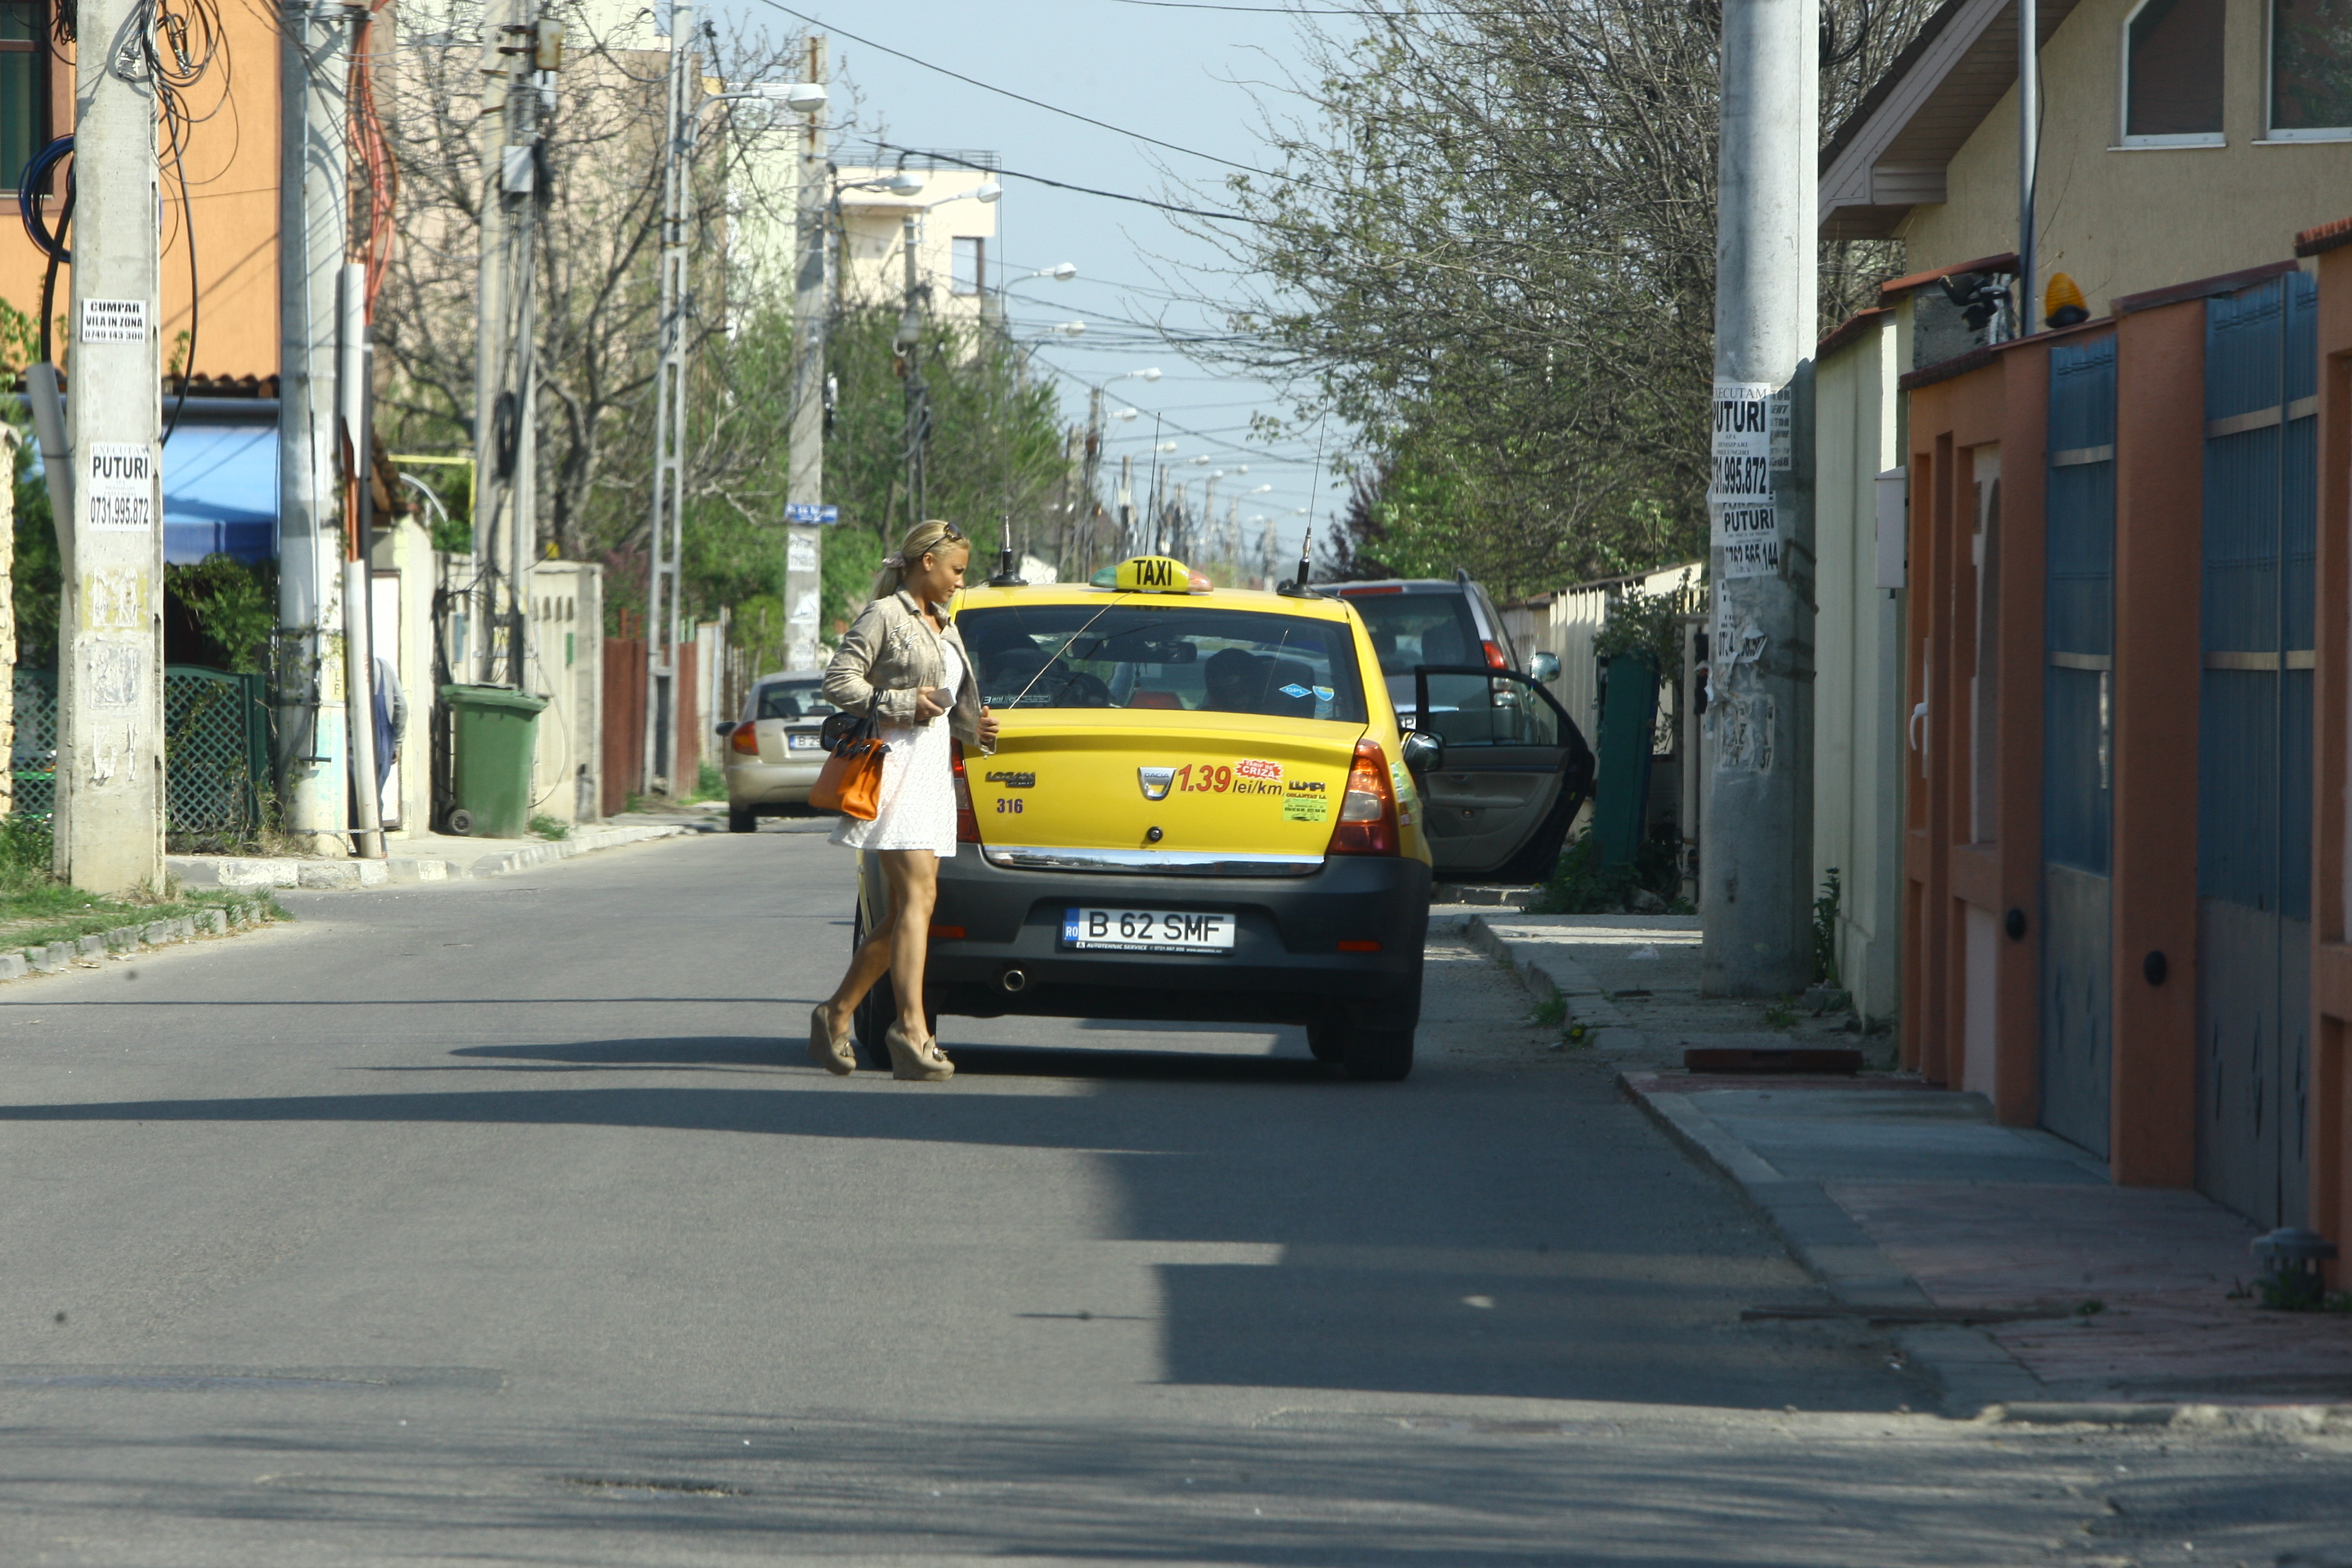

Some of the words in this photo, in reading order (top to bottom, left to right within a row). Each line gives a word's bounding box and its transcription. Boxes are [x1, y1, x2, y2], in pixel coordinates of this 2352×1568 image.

[90, 301, 140, 313] CUMPAR
[86, 315, 106, 326] VILA
[108, 315, 117, 327] IN
[119, 316, 143, 327] ZONA
[1713, 388, 1767, 399] XECUTAM
[93, 456, 148, 479] PUTURI
[90, 496, 148, 524] 0731.995.872
[1725, 508, 1775, 532] PUTURI
[1133, 560, 1172, 586] TAXI
[799, 736, 806, 746] B
[1178, 764, 1231, 792] 1.39
[1242, 765, 1275, 778] CRIZA
[1232, 779, 1282, 795] lei/km
[997, 799, 1023, 814] 316
[1067, 927, 1078, 937] RO
[1089, 911, 1109, 937] B
[1121, 912, 1154, 939] 62
[1163, 914, 1224, 941] SMF
